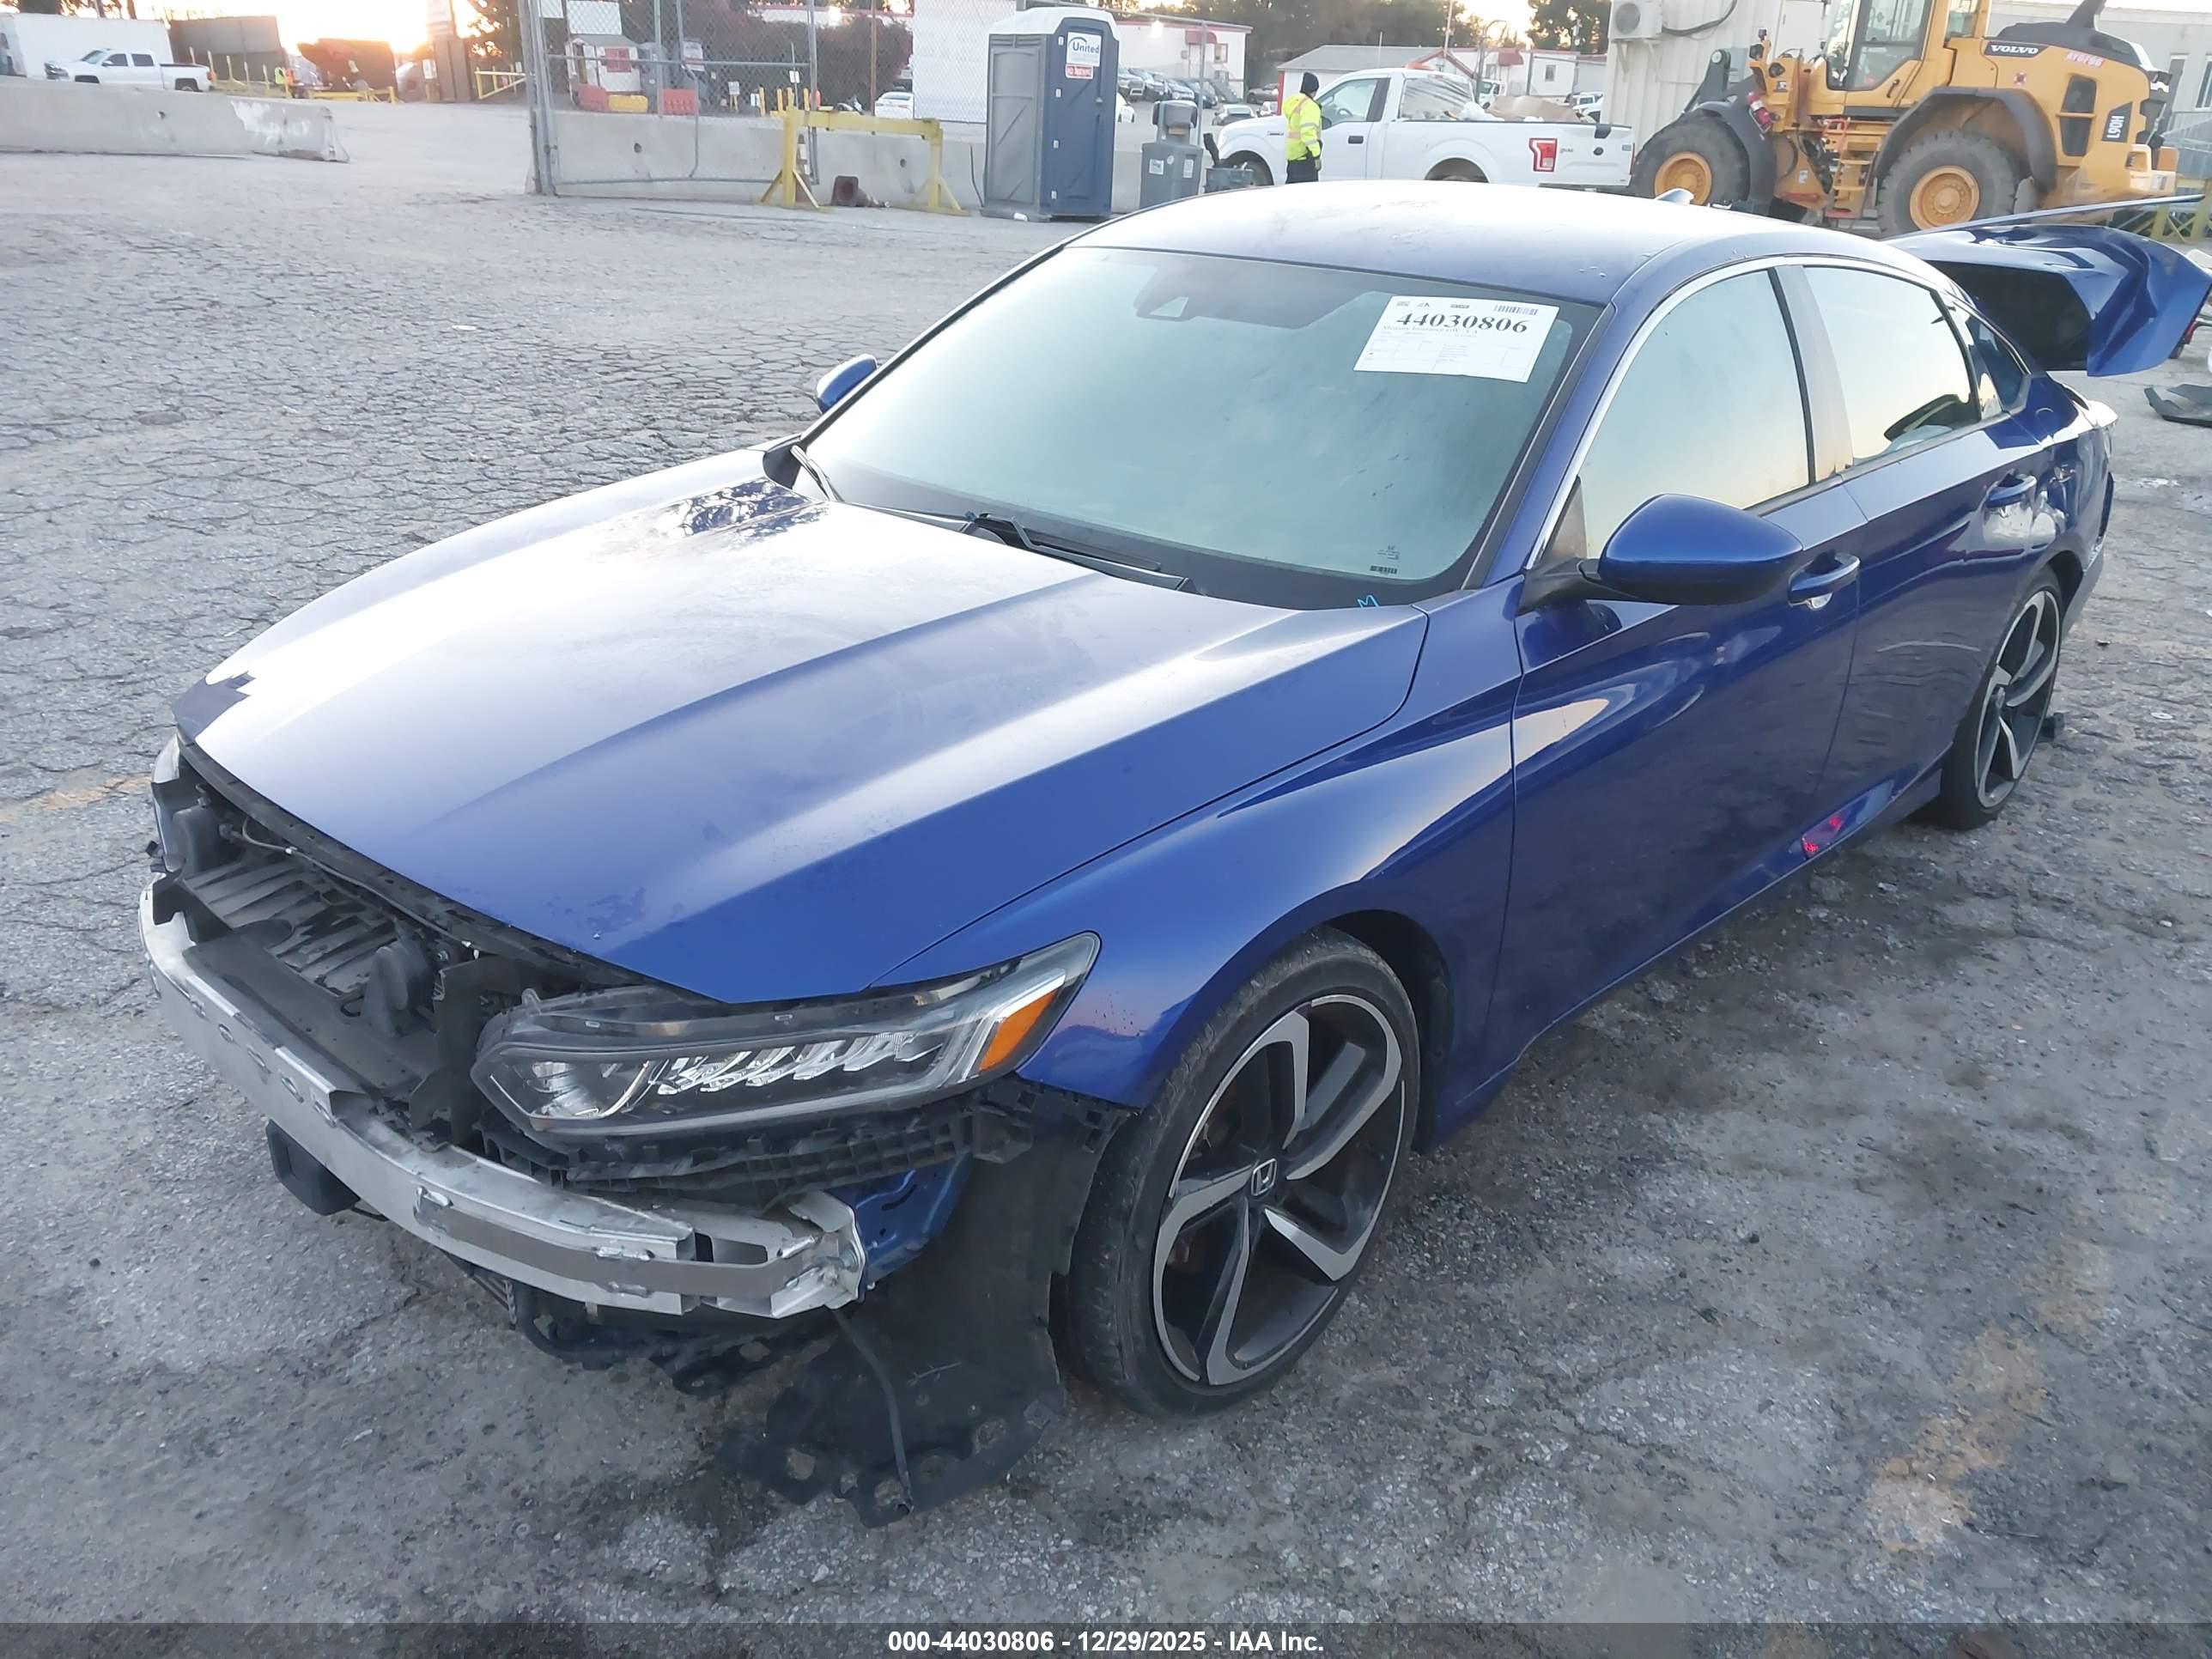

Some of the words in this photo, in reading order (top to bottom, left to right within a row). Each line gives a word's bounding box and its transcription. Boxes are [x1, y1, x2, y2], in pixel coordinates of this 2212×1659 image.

[1073, 41, 1100, 53] United
[1990, 45, 2039, 55] VOLVO
[2106, 115, 2125, 139] L90H
[1396, 313, 1529, 334] 44030806
